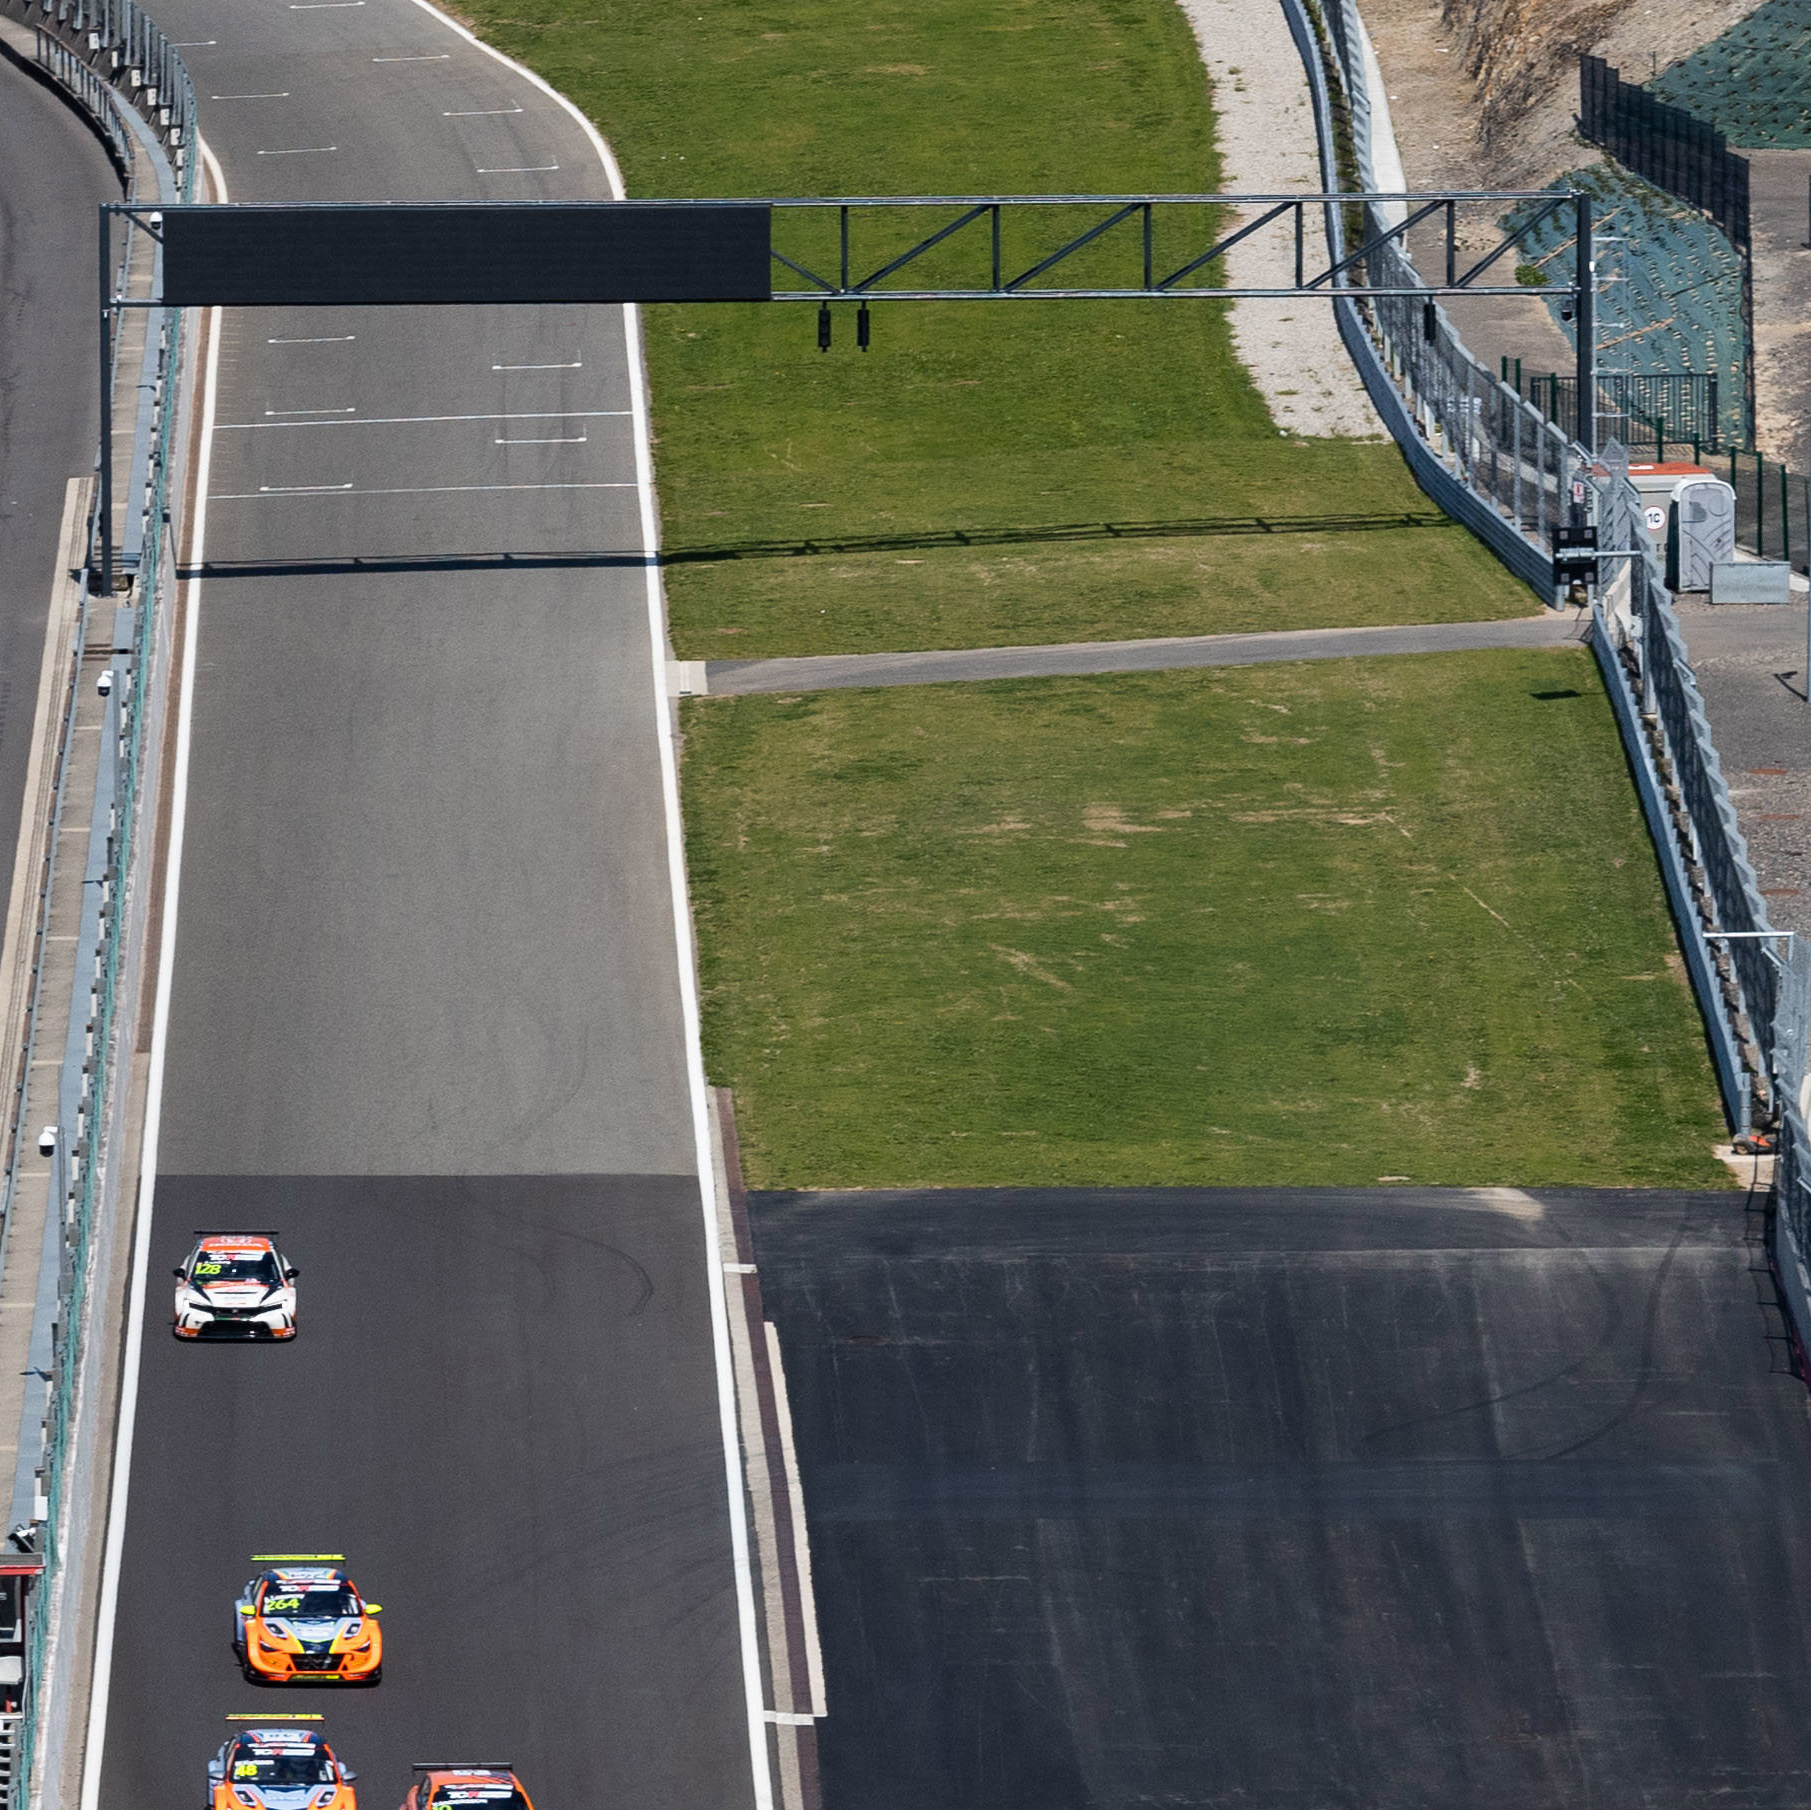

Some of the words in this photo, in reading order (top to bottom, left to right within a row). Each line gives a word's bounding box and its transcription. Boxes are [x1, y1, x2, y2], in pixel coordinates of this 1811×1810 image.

[1648, 512, 1661, 524] 1C
[195, 1263, 222, 1275] 128
[265, 1598, 300, 1611] 264
[234, 1764, 258, 1776] 48
